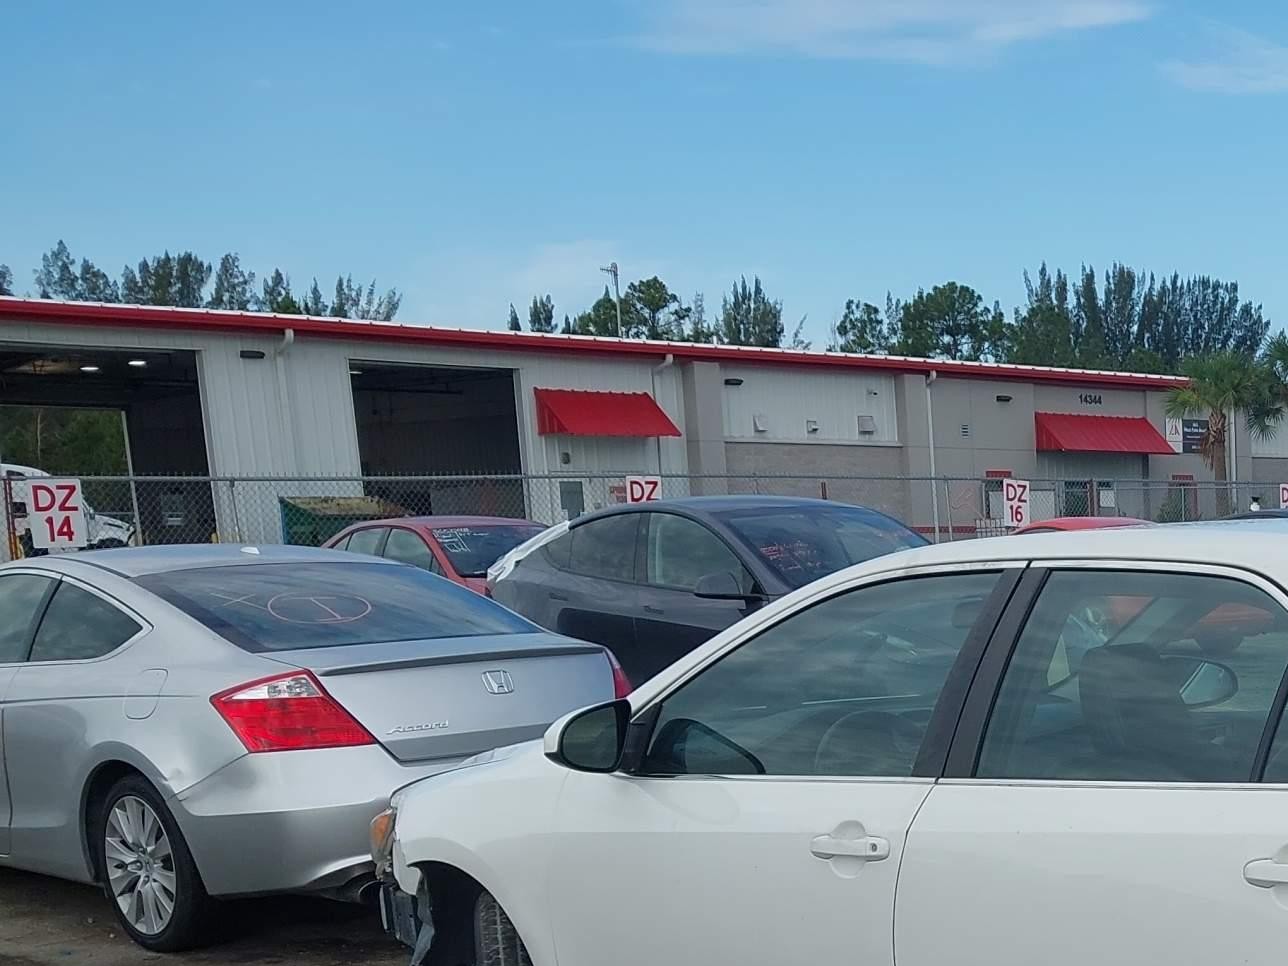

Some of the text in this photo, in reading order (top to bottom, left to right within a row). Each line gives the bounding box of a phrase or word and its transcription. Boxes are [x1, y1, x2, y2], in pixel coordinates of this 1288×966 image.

[1079, 393, 1102, 405] 14344
[31, 485, 79, 512] DZ
[627, 480, 658, 502] DZ
[1005, 483, 1028, 503] DZ
[1009, 505, 1024, 523] 16
[44, 515, 75, 542] 14
